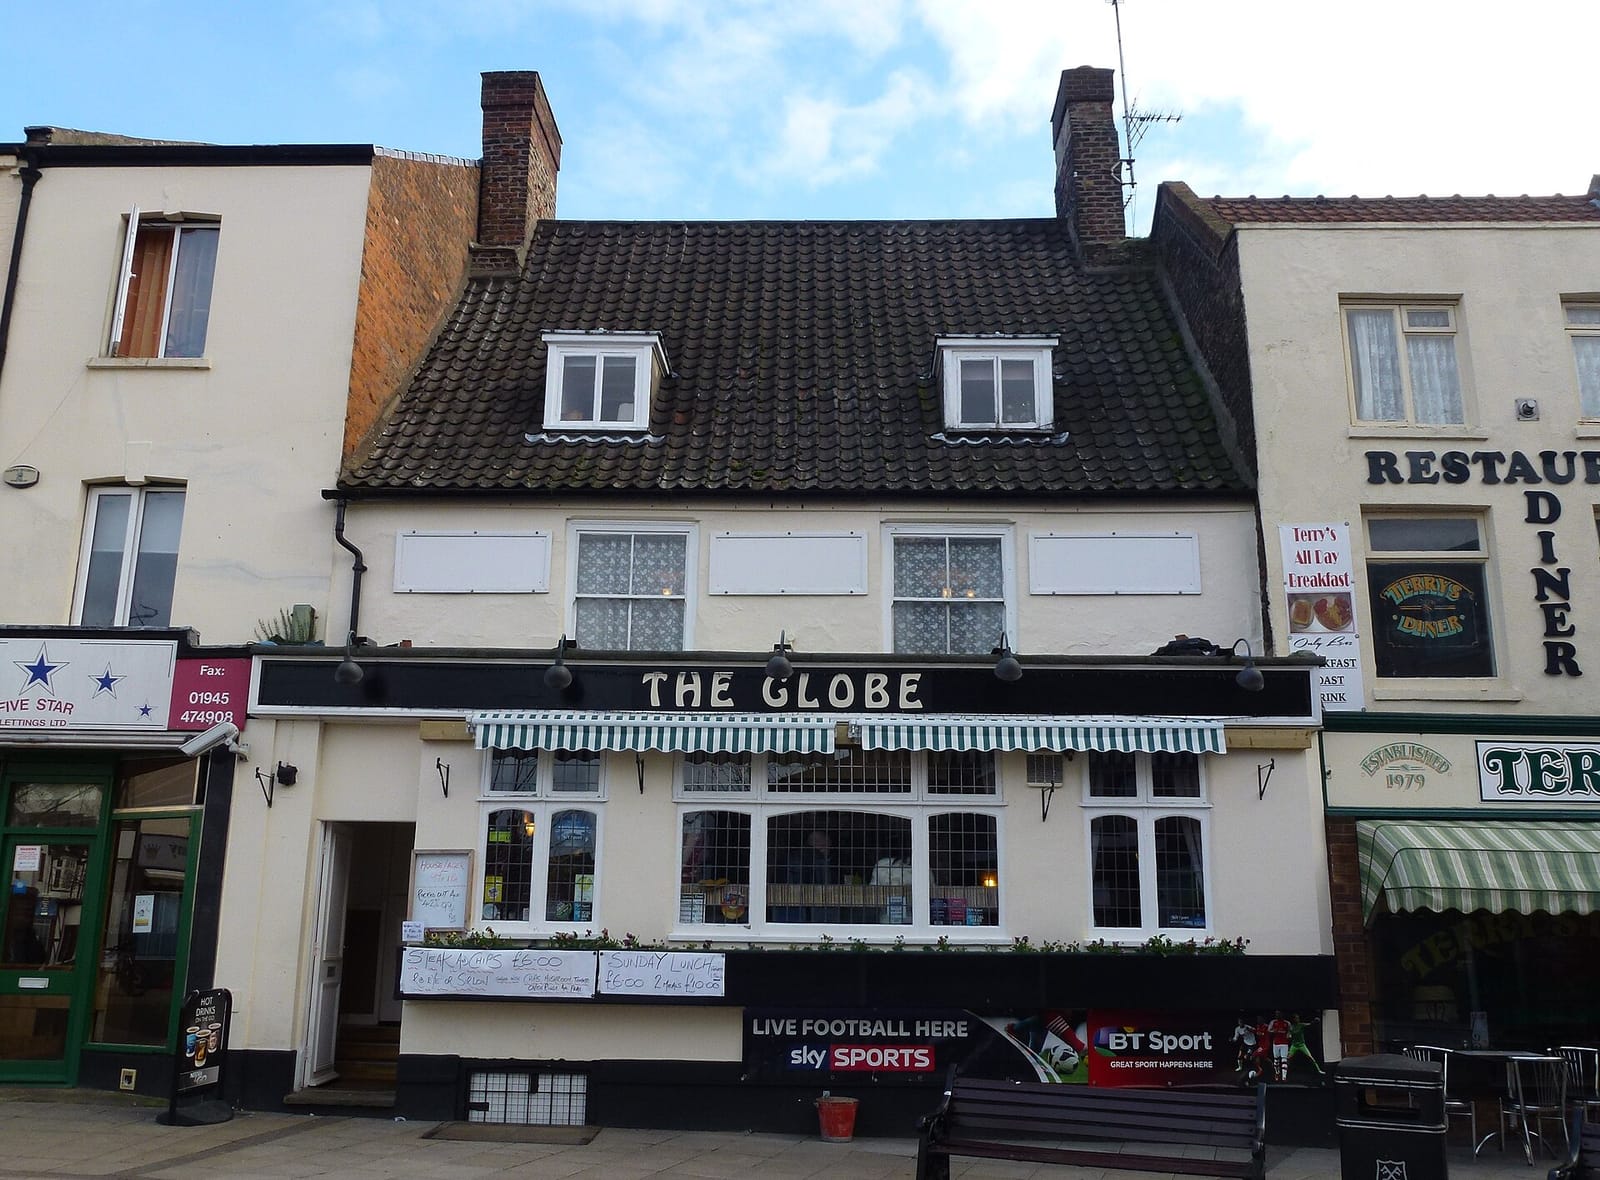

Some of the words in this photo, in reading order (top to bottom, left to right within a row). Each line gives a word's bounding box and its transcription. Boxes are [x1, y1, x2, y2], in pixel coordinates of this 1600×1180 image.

[1292, 526, 1337, 542] Terry's
[1295, 549, 1312, 565] All
[1314, 549, 1339, 565] Day
[1287, 571, 1350, 588] Breakfast
[1523, 490, 1583, 677] DINER
[1397, 615, 1463, 639] DINER
[200, 665, 225, 676] Fax:
[189, 692, 230, 705] 01945
[642, 672, 735, 707] THE
[762, 673, 924, 709] GLOBE
[1320, 692, 1347, 702] RINK
[36, 698, 74, 715] STAR
[0, 719, 46, 727] LETTINGS
[49, 719, 67, 727] LTD
[180, 711, 234, 725] 474908
[1361, 744, 1450, 777] ESTABLISHED
[1483, 747, 1600, 796] TER
[1386, 773, 1426, 792] 1979
[407, 949, 455, 972] STEAK
[608, 952, 668, 969] SUNDAY
[670, 953, 713, 974] LUNCH
[201, 997, 214, 1006] HOT
[196, 1006, 216, 1017] DRINKS
[752, 1019, 796, 1036] LIVE
[802, 1019, 910, 1037] FOOTBALL
[915, 1020, 968, 1037] HERE
[1109, 1033, 1145, 1050] BT
[1149, 1031, 1212, 1054] Sport
[791, 1045, 826, 1068] sky
[834, 1048, 930, 1067] SPORTS
